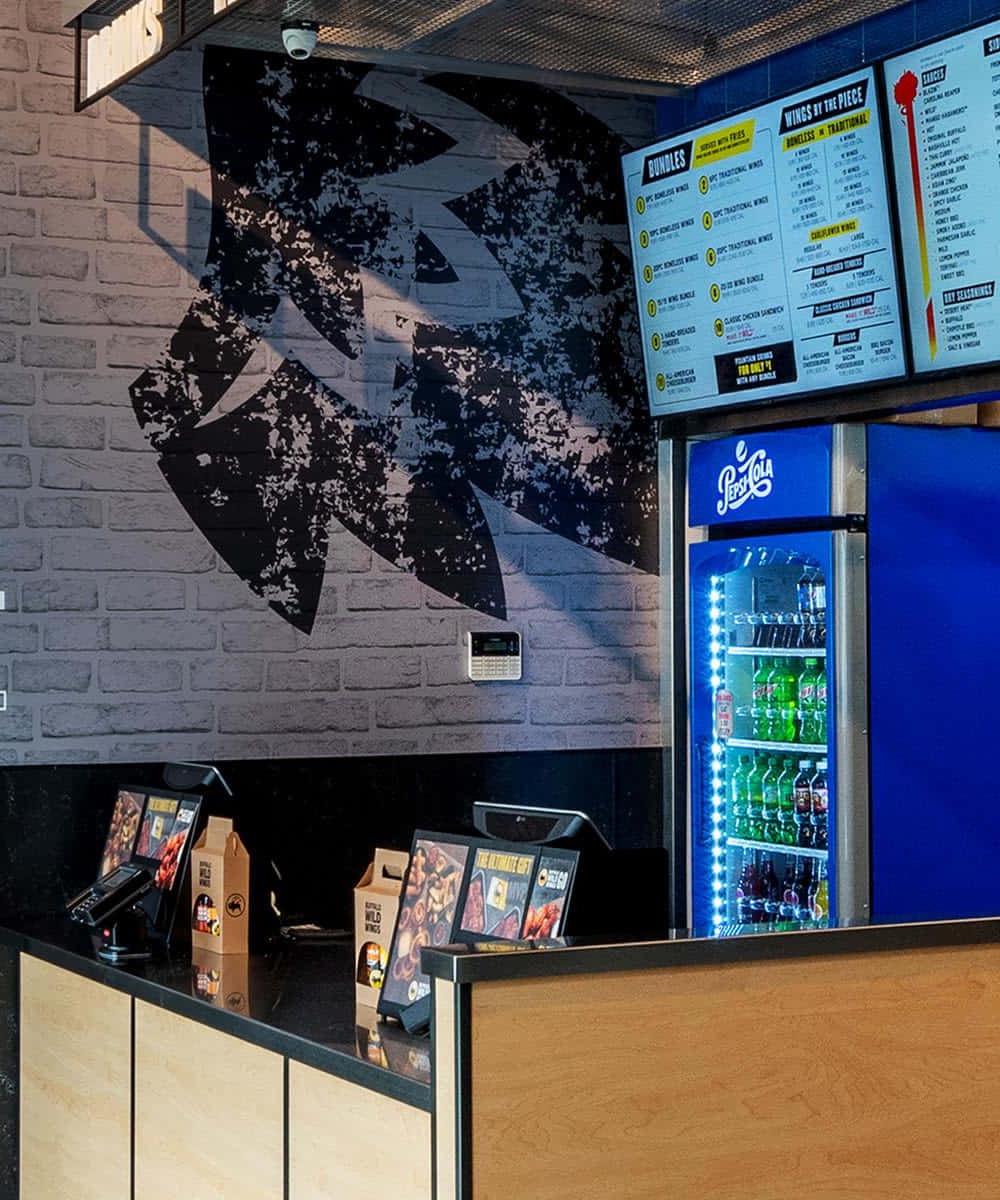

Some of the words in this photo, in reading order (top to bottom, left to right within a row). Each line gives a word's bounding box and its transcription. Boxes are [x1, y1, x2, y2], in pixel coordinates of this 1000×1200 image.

[784, 105, 812, 126] WINGS
[813, 102, 822, 115] BY
[824, 97, 837, 112] THE
[838, 87, 863, 108] PIECE
[730, 130, 744, 140] FRIES
[786, 130, 814, 147] BONELESS
[827, 113, 867, 134] TRADITIONAL
[647, 150, 685, 176] BUNDLES
[748, 159, 763, 169] WINGS
[676, 183, 688, 192] WINGS
[724, 200, 752, 214] TRADITIONAL
[754, 195, 768, 205] WINGS
[681, 218, 694, 227] WINGS
[728, 238, 756, 251] TRADITIONAL
[758, 233, 772, 242] WINGS
[685, 253, 698, 262] WINGS
[738, 364, 749, 375] FOR
[365, 910, 382, 924] WILD
